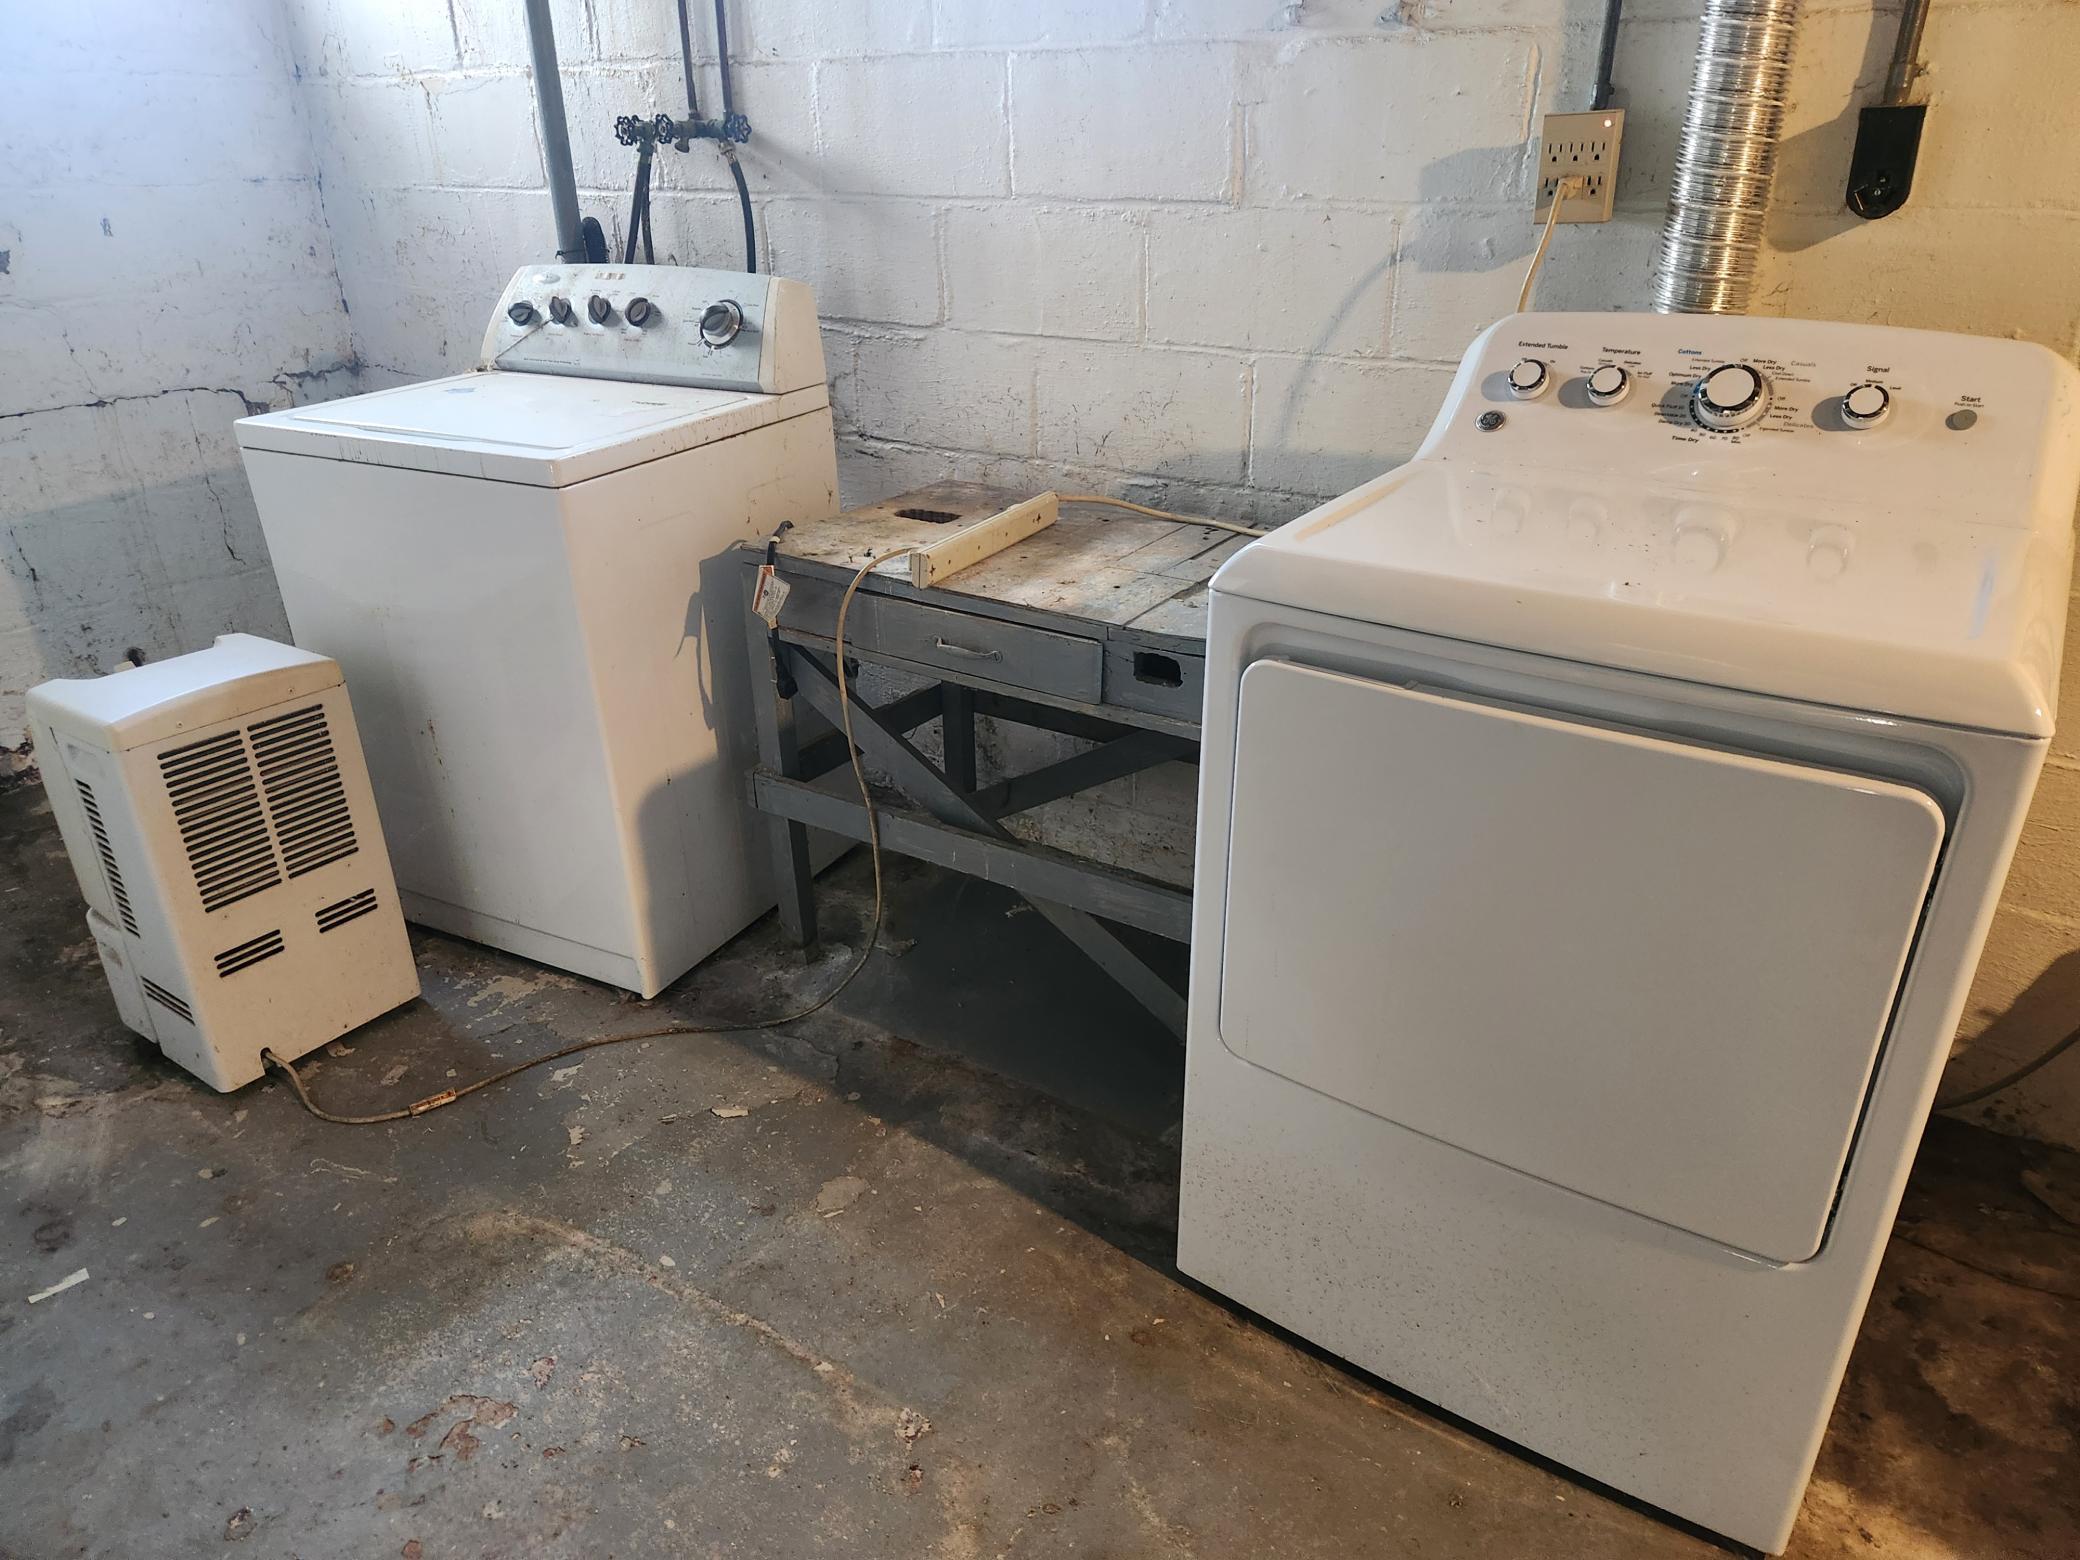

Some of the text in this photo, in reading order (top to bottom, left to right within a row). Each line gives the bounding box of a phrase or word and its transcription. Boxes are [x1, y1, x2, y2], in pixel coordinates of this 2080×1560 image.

[1518, 341, 1546, 349] Extended
[1602, 347, 1641, 355] Temperature
[1866, 365, 1890, 374] Signal
[1961, 395, 1981, 403] Start
